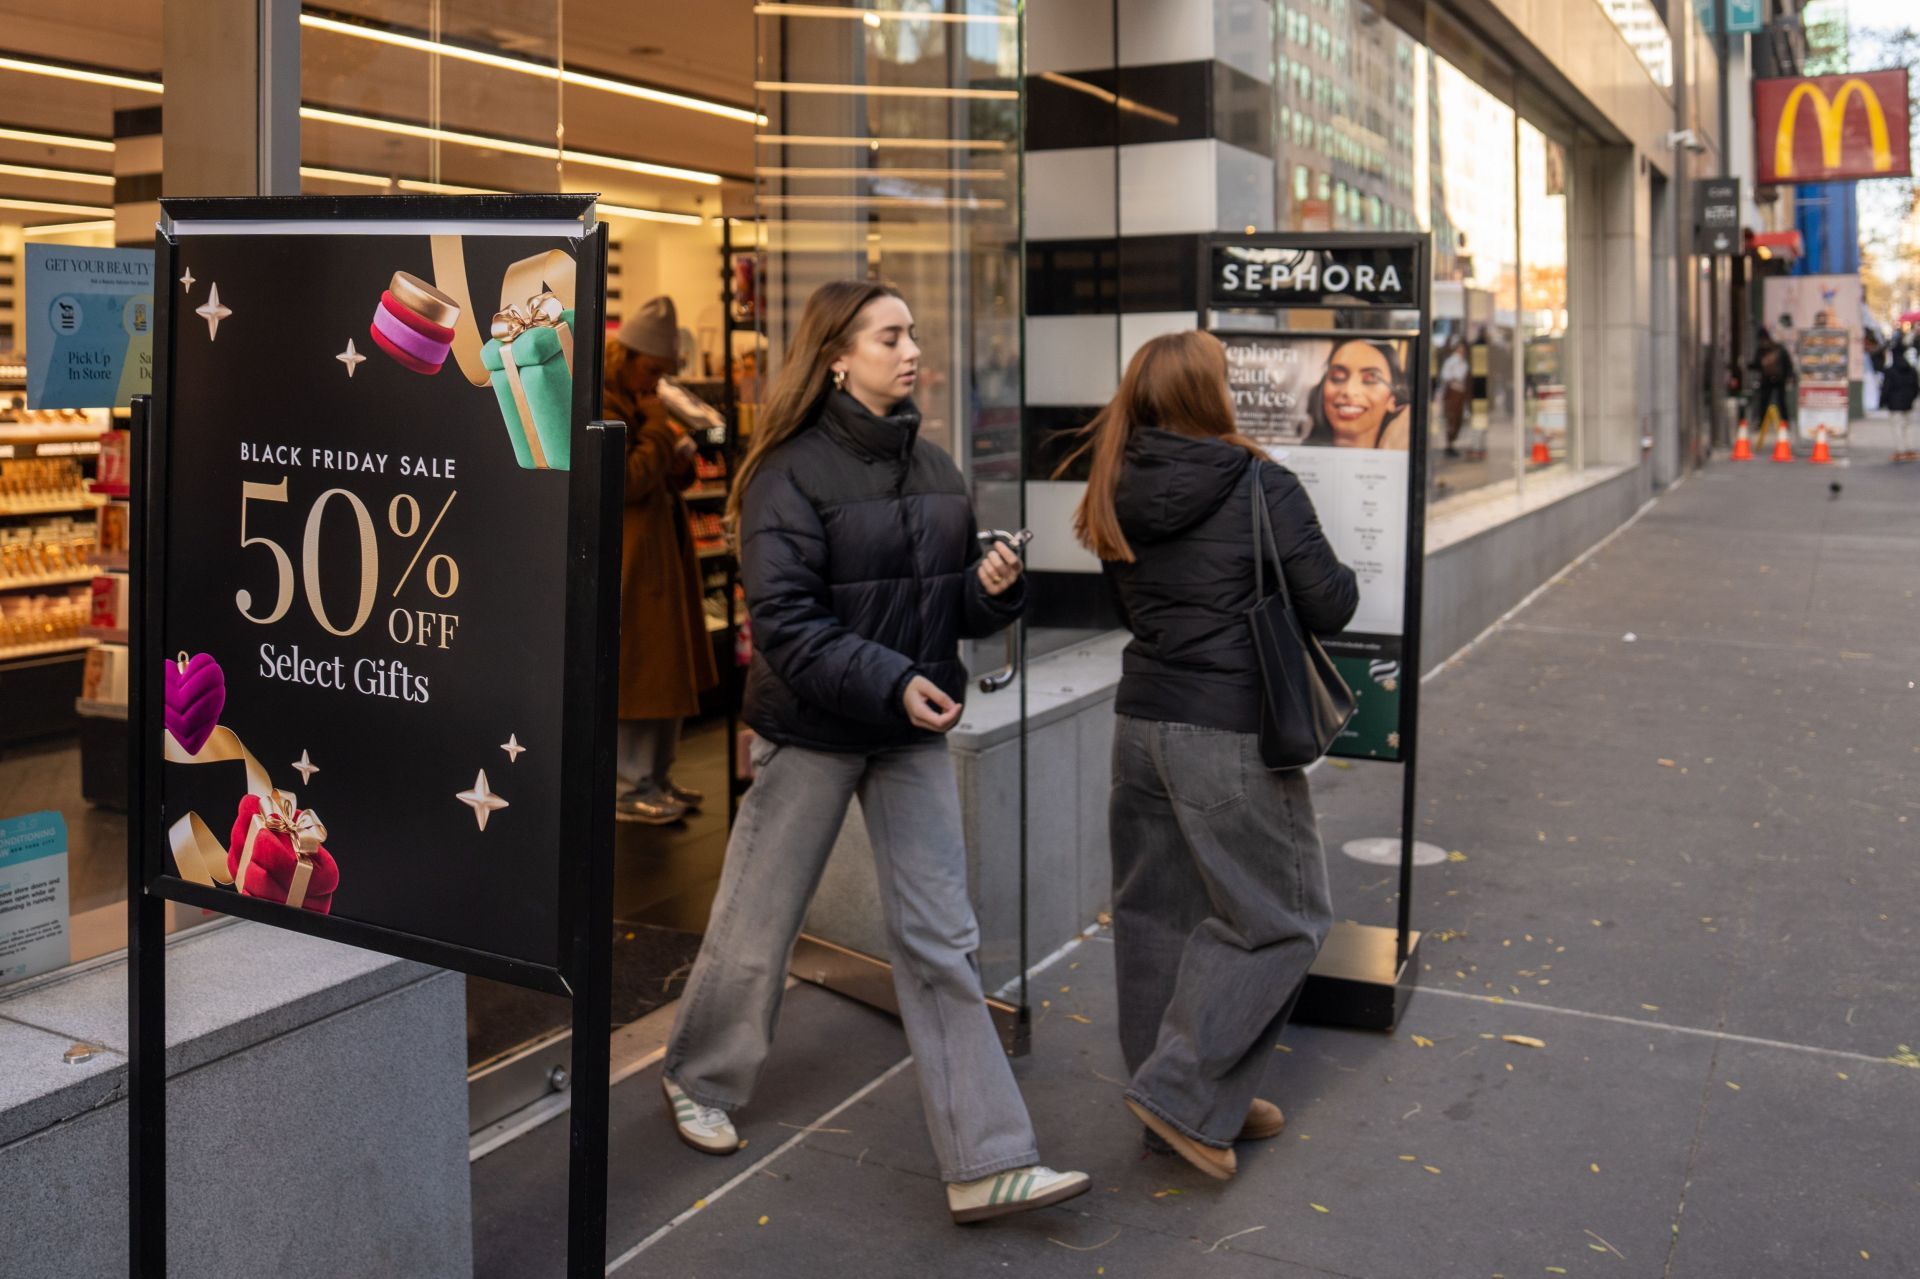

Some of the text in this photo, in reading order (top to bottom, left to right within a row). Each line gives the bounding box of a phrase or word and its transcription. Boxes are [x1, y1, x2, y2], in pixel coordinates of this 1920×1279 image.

[45, 258, 150, 276] GET YOUR BEAUTY
[1222, 263, 1402, 292] SEPHORA
[68, 351, 111, 367] Pick Up
[139, 351, 152, 364] Sa
[1223, 342, 1298, 366] ephora
[69, 367, 112, 380] In Store
[1228, 366, 1284, 390] eauty
[1231, 386, 1297, 408] ervices
[240, 442, 456, 479] BLACK FRIDAY SALE
[235, 475, 460, 637] 50%
[388, 608, 459, 649] OFF
[259, 643, 429, 703] Select Gifts
[0, 827, 56, 849] ONDITIONING
